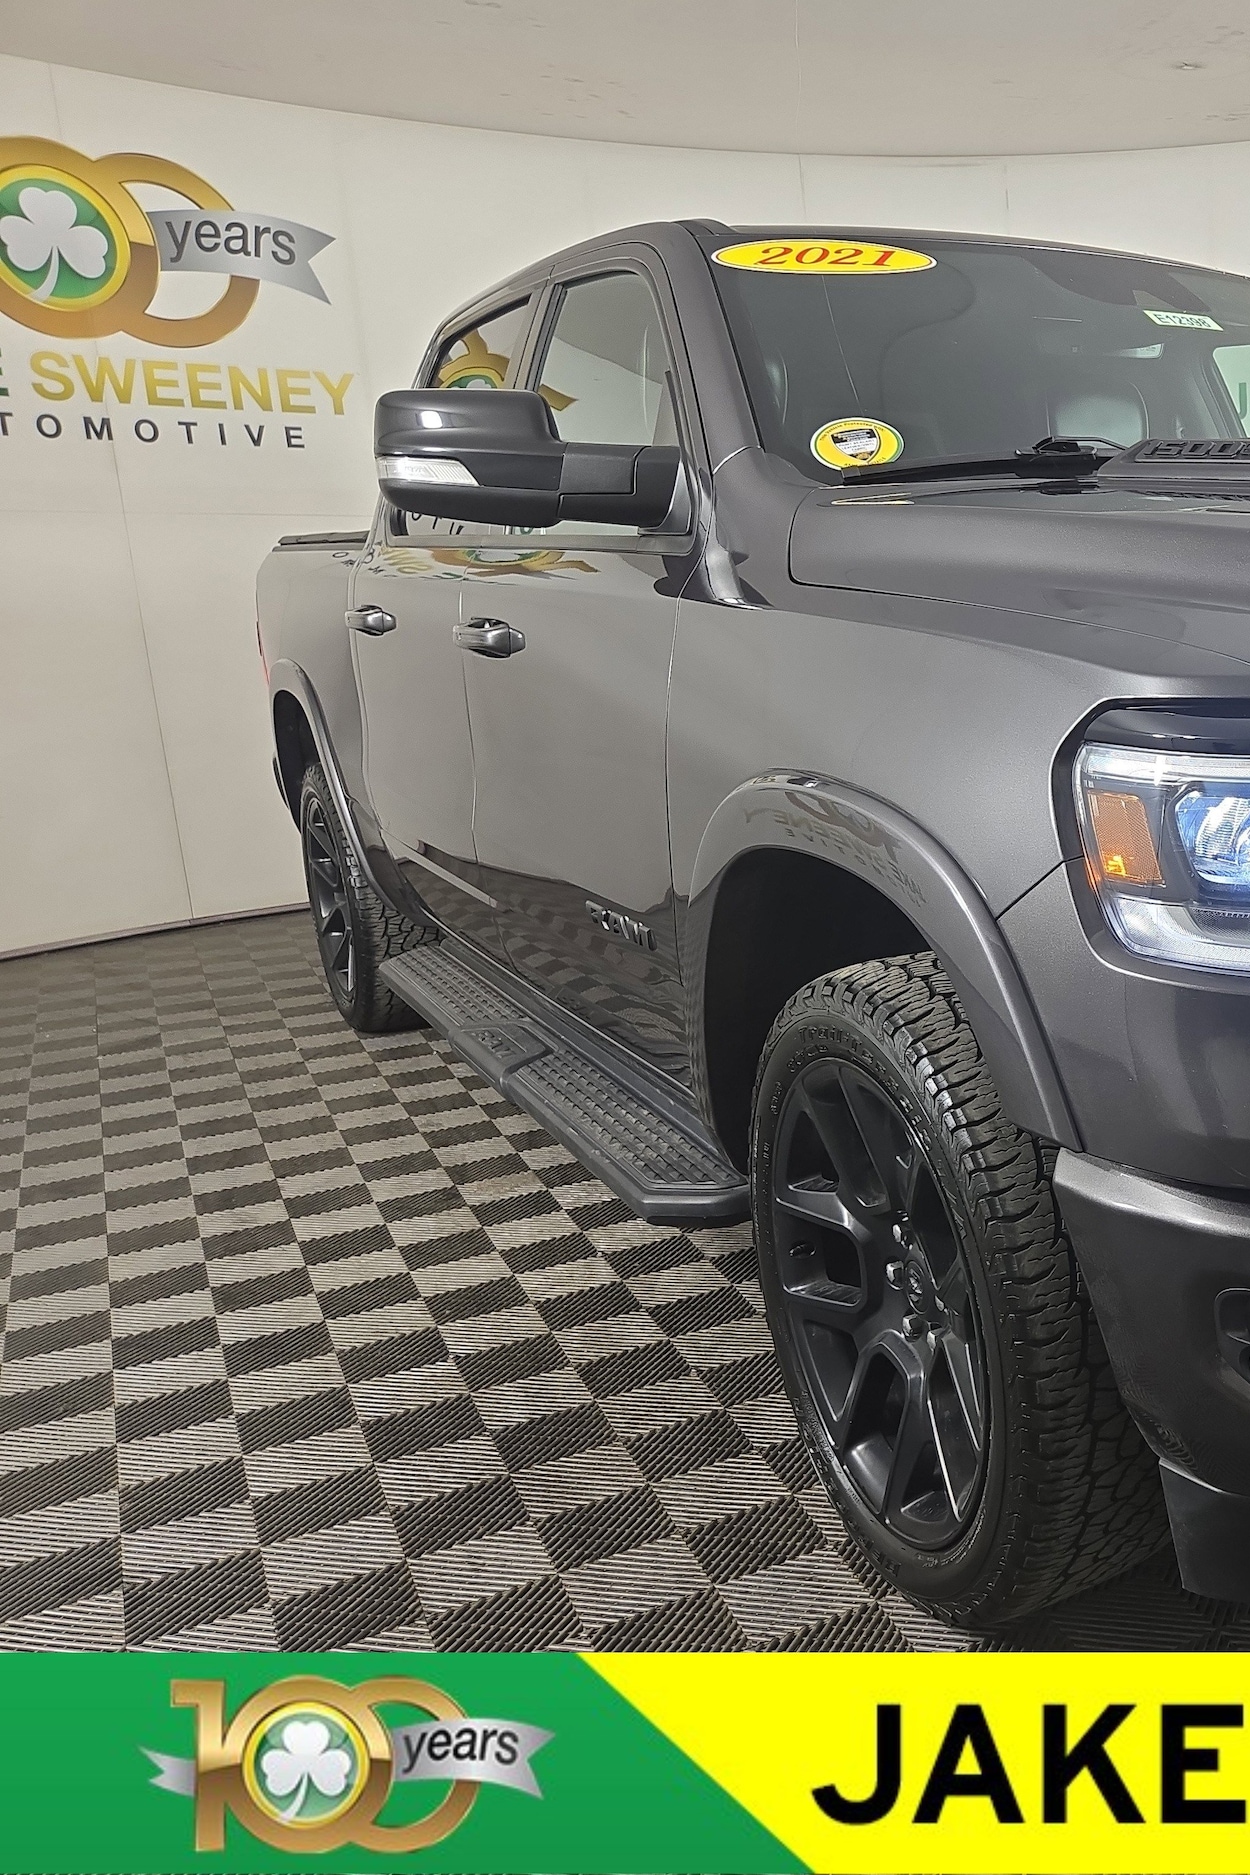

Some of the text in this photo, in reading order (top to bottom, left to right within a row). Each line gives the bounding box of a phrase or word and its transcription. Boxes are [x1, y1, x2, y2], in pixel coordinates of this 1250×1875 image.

[165, 217, 297, 266] years
[753, 246, 897, 267] 2021
[29, 350, 355, 416] SWEENEY
[1143, 441, 1243, 458] 1500
[585, 900, 658, 951] RAM
